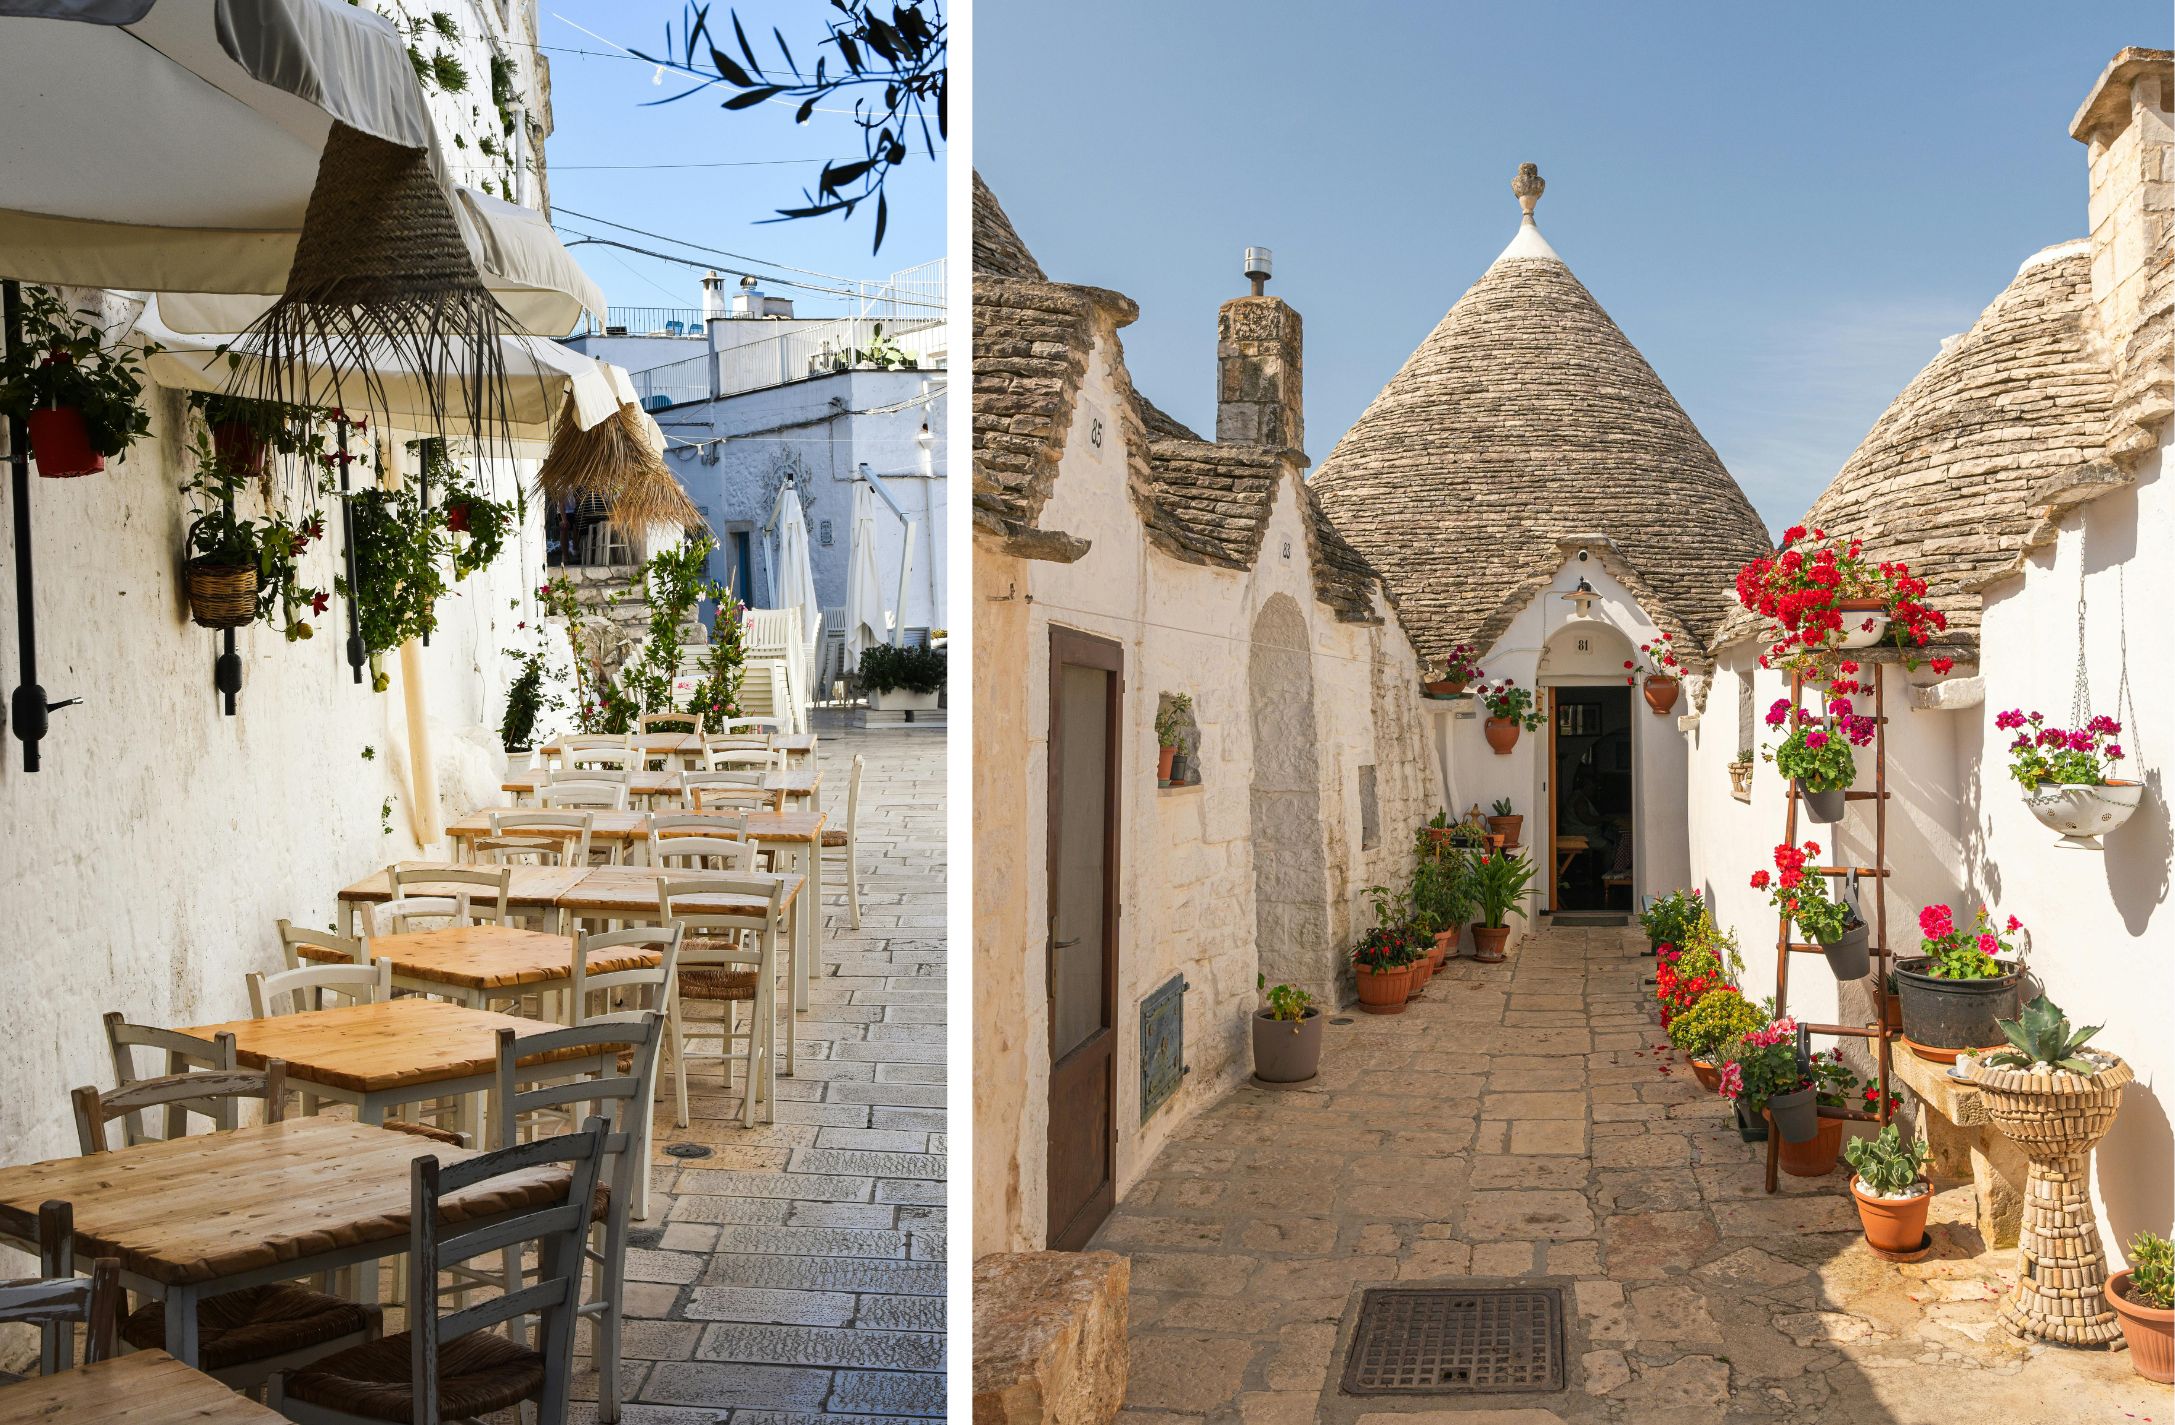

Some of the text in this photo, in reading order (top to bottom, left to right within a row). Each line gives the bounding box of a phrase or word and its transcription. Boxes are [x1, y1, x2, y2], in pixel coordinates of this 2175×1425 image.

[1091, 417, 1102, 448] 85
[1282, 542, 1291, 559] 83
[1578, 639, 1588, 651] 81
